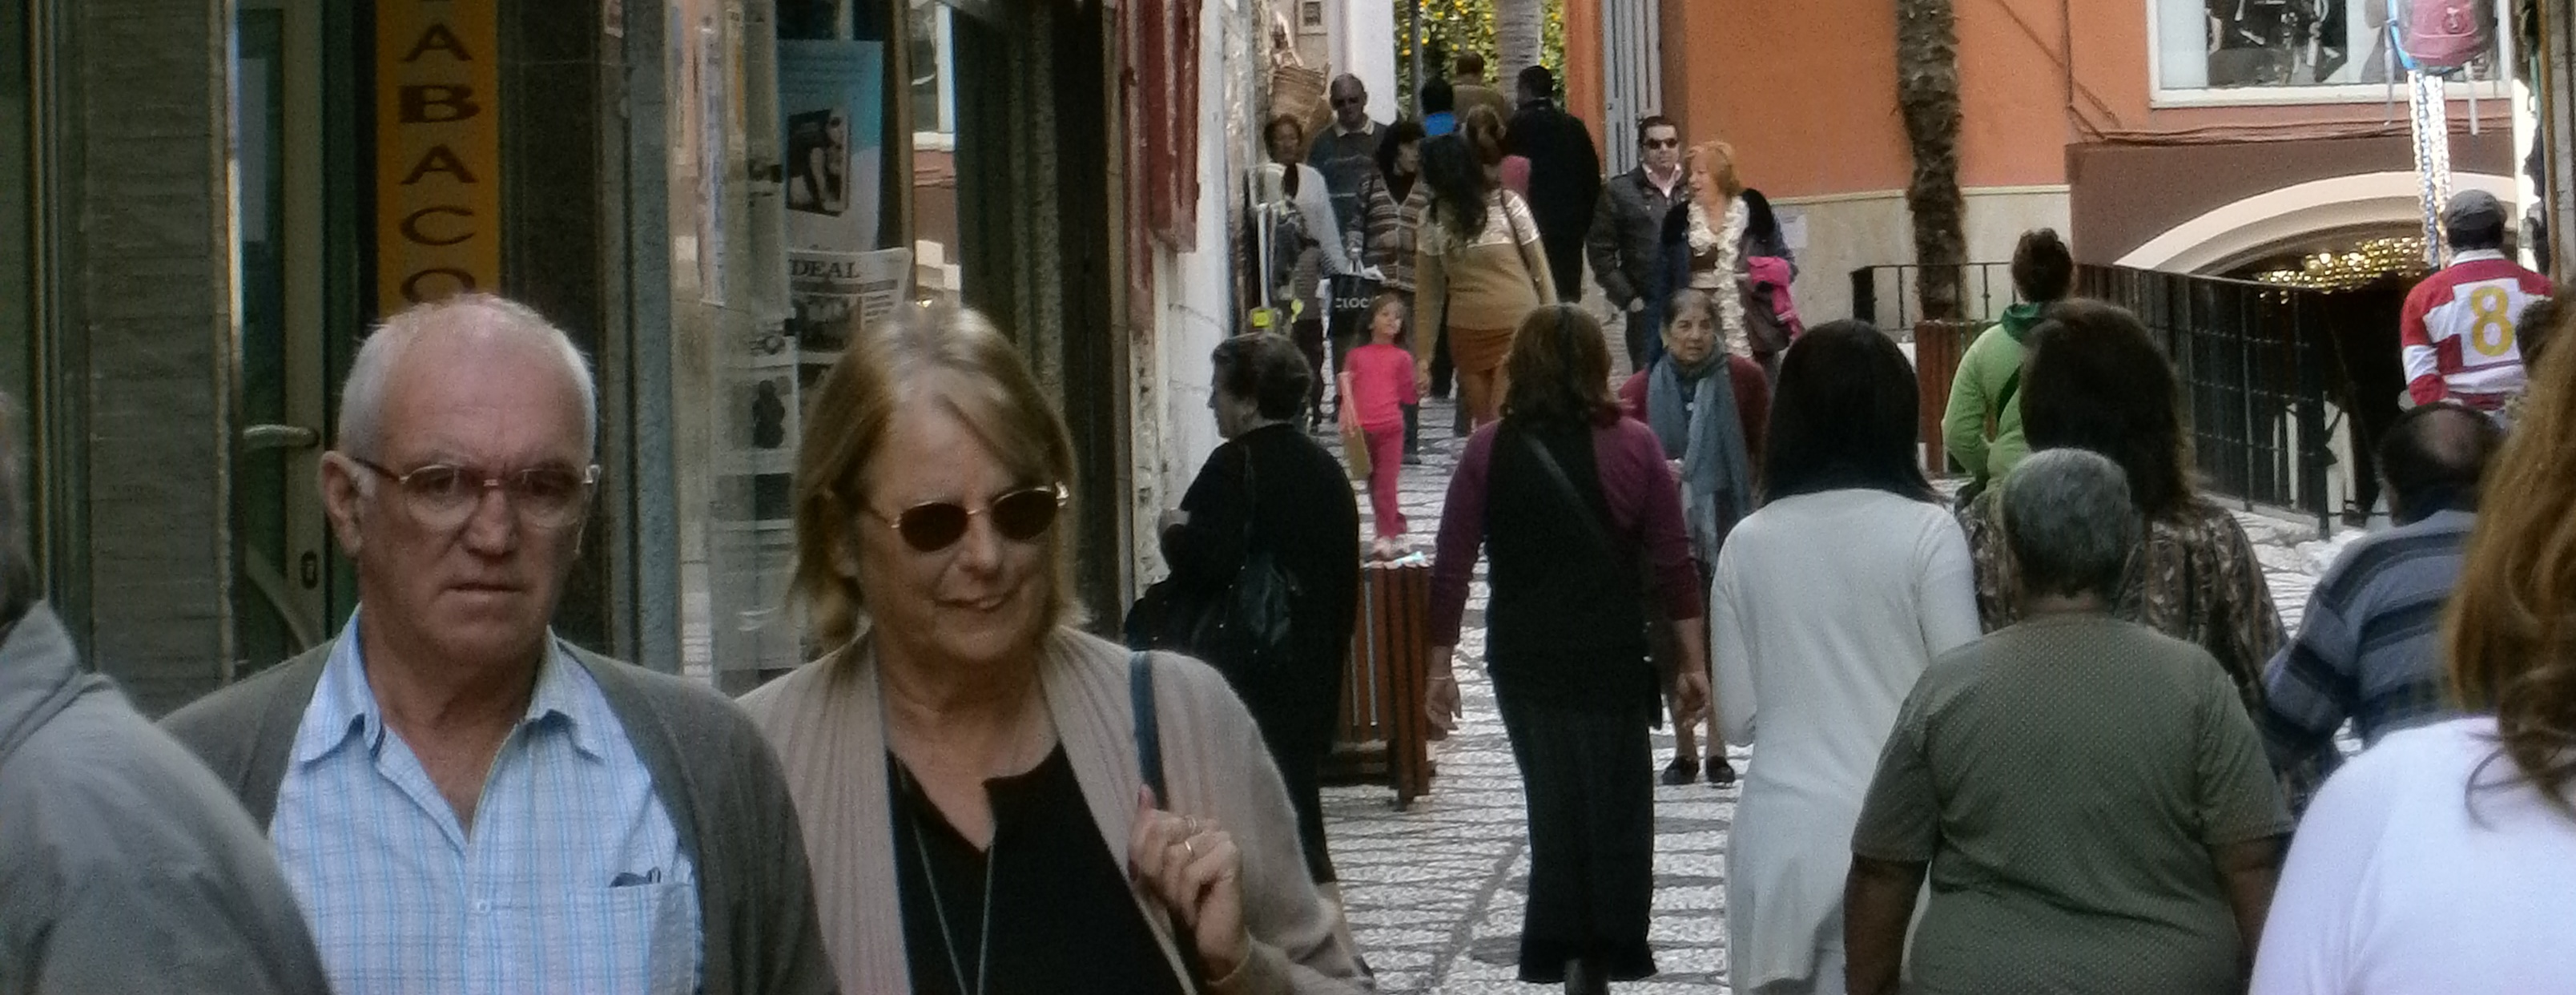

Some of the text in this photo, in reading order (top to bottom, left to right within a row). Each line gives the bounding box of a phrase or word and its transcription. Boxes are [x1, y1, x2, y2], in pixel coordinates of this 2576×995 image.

[398, 0, 481, 302] ABACO
[788, 258, 860, 278] DEAL
[2471, 287, 2514, 357] 8
